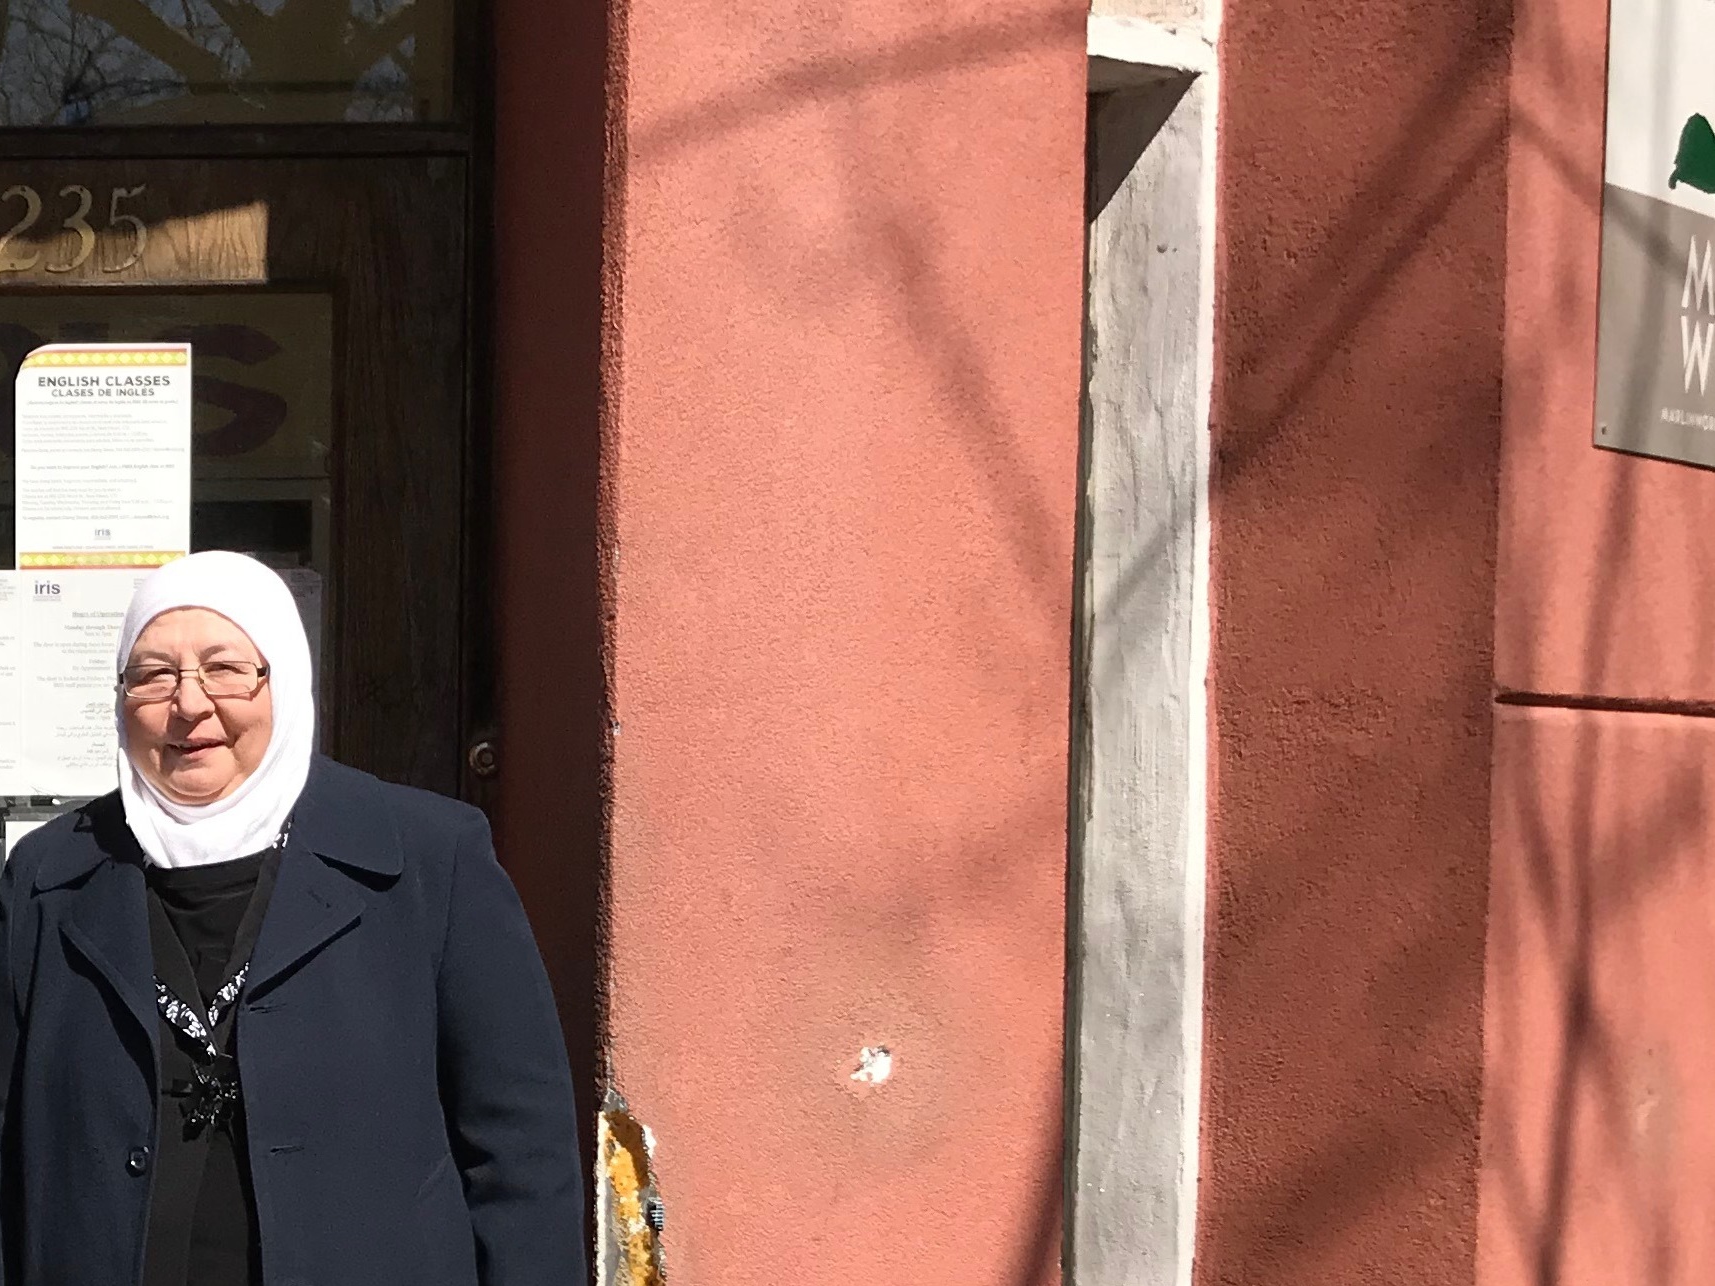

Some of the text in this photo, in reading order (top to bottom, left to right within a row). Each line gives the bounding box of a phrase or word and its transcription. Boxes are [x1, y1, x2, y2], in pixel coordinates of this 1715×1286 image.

[38, 375, 171, 387] ENGLISH CLASSES
[51, 388, 94, 397] CLASES
[97, 388, 112, 397] DE
[94, 528, 111, 537] iris
[34, 580, 61, 595] iris
